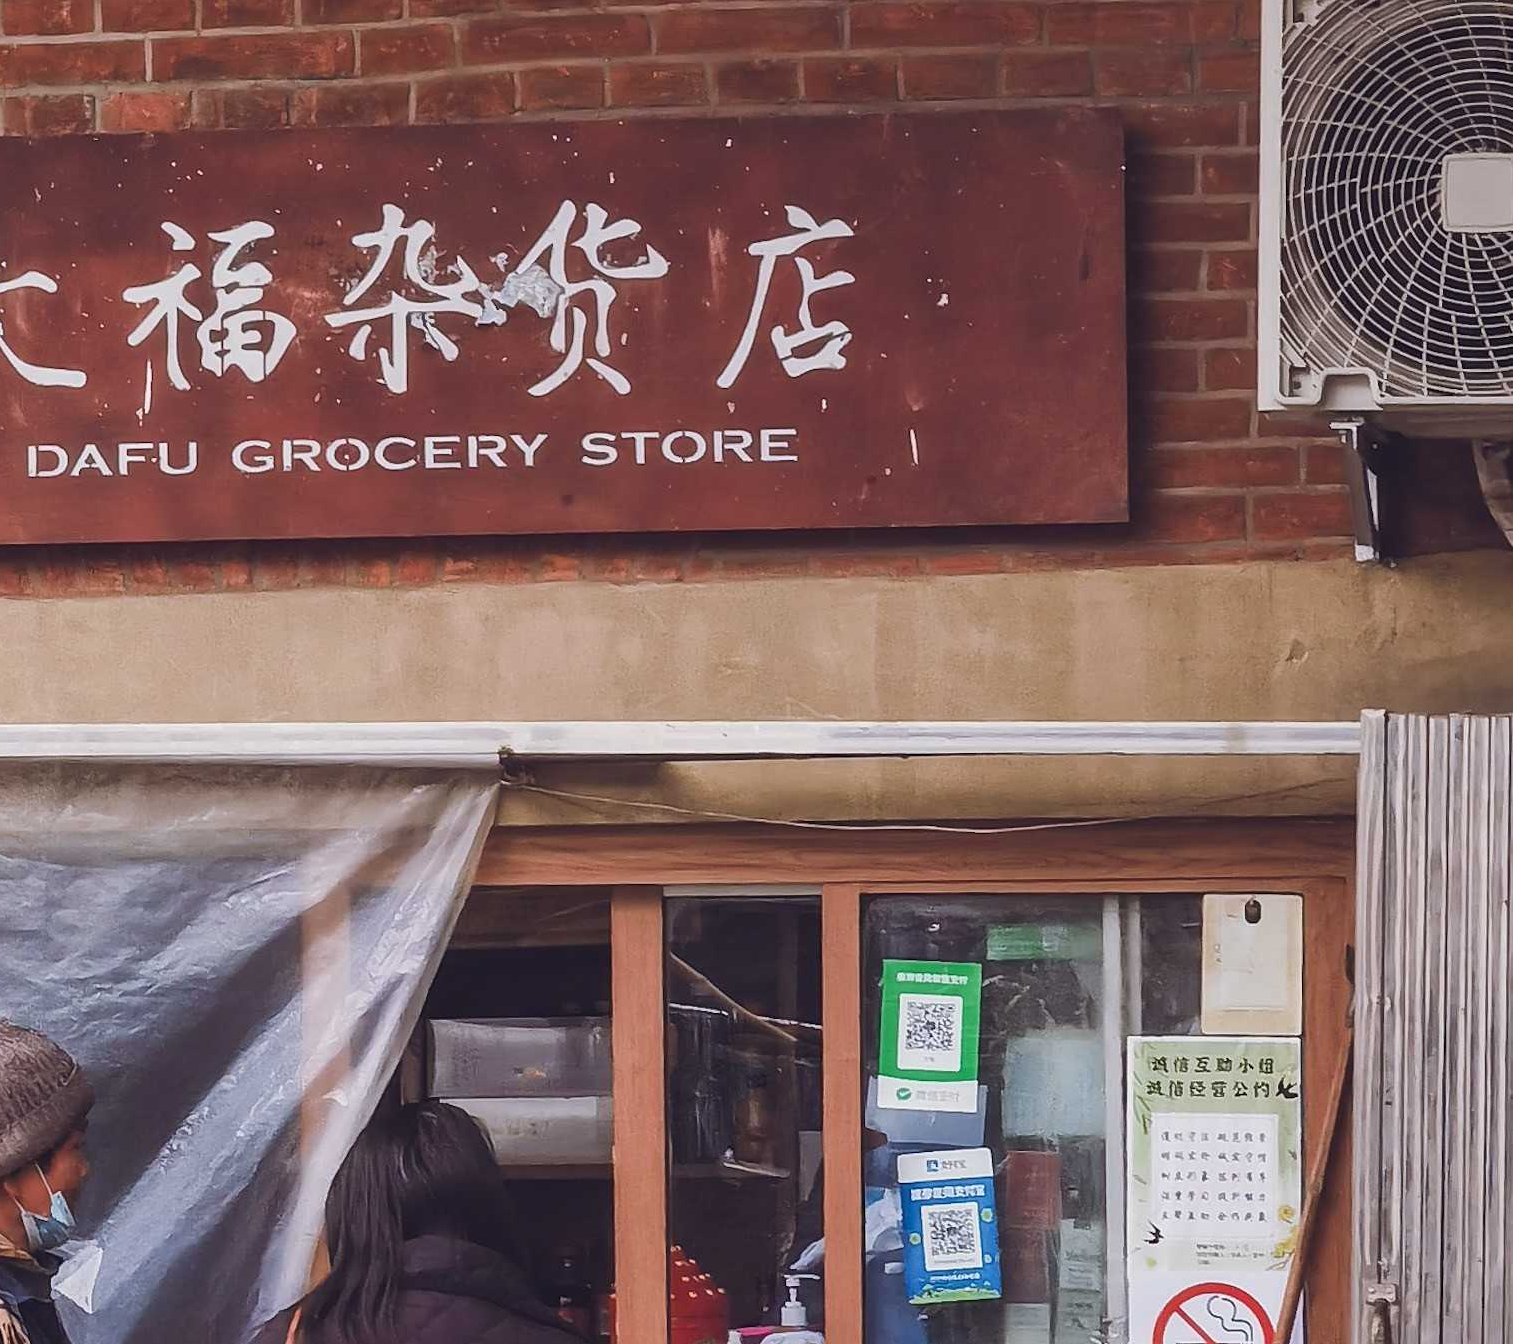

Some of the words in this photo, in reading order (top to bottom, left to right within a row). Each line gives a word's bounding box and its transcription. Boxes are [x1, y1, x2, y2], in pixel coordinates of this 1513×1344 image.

[27, 441, 199, 478] DAFU
[231, 432, 549, 473] GROCERY
[580, 428, 798, 465] STORE
